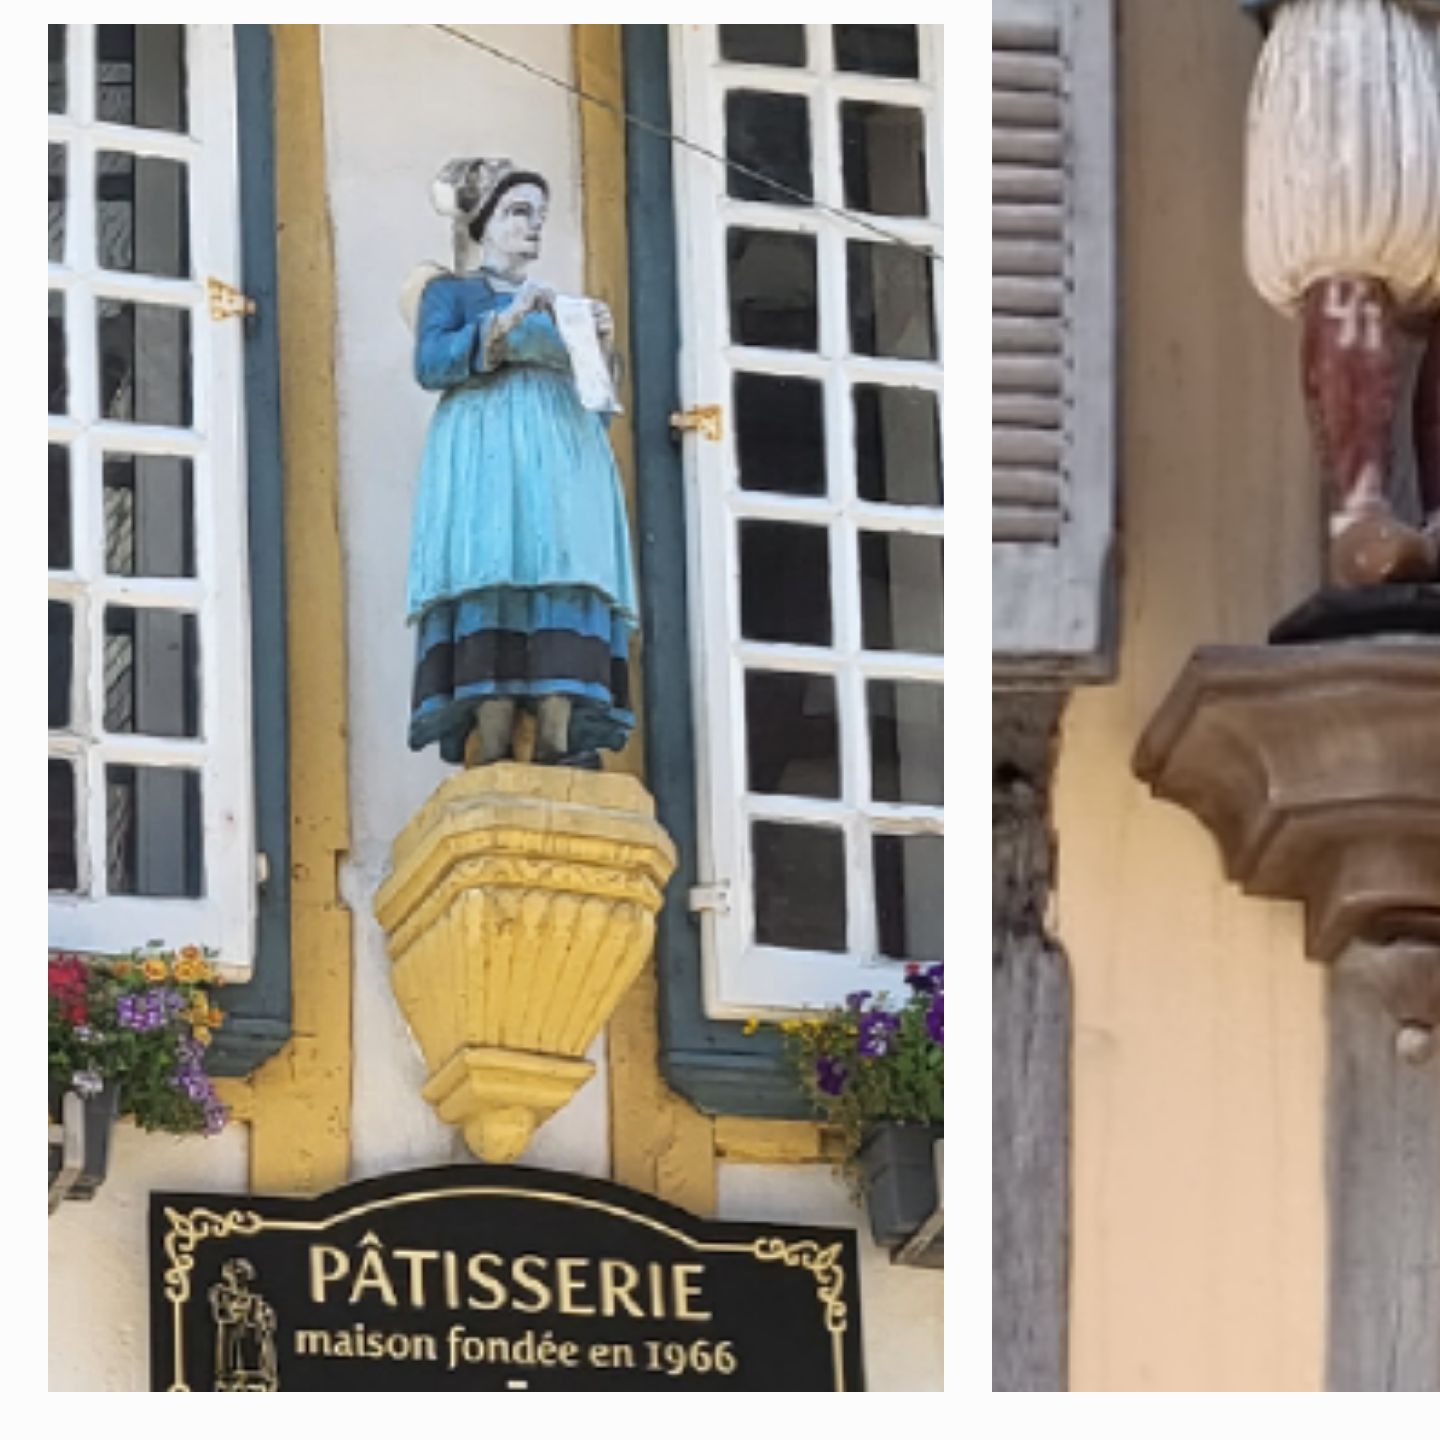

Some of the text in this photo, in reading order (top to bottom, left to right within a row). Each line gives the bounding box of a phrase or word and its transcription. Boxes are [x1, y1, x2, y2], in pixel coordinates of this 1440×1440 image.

[308, 1229, 713, 1321] PÂTISSERIE
[294, 1322, 738, 1376] maison fondée en 1966
